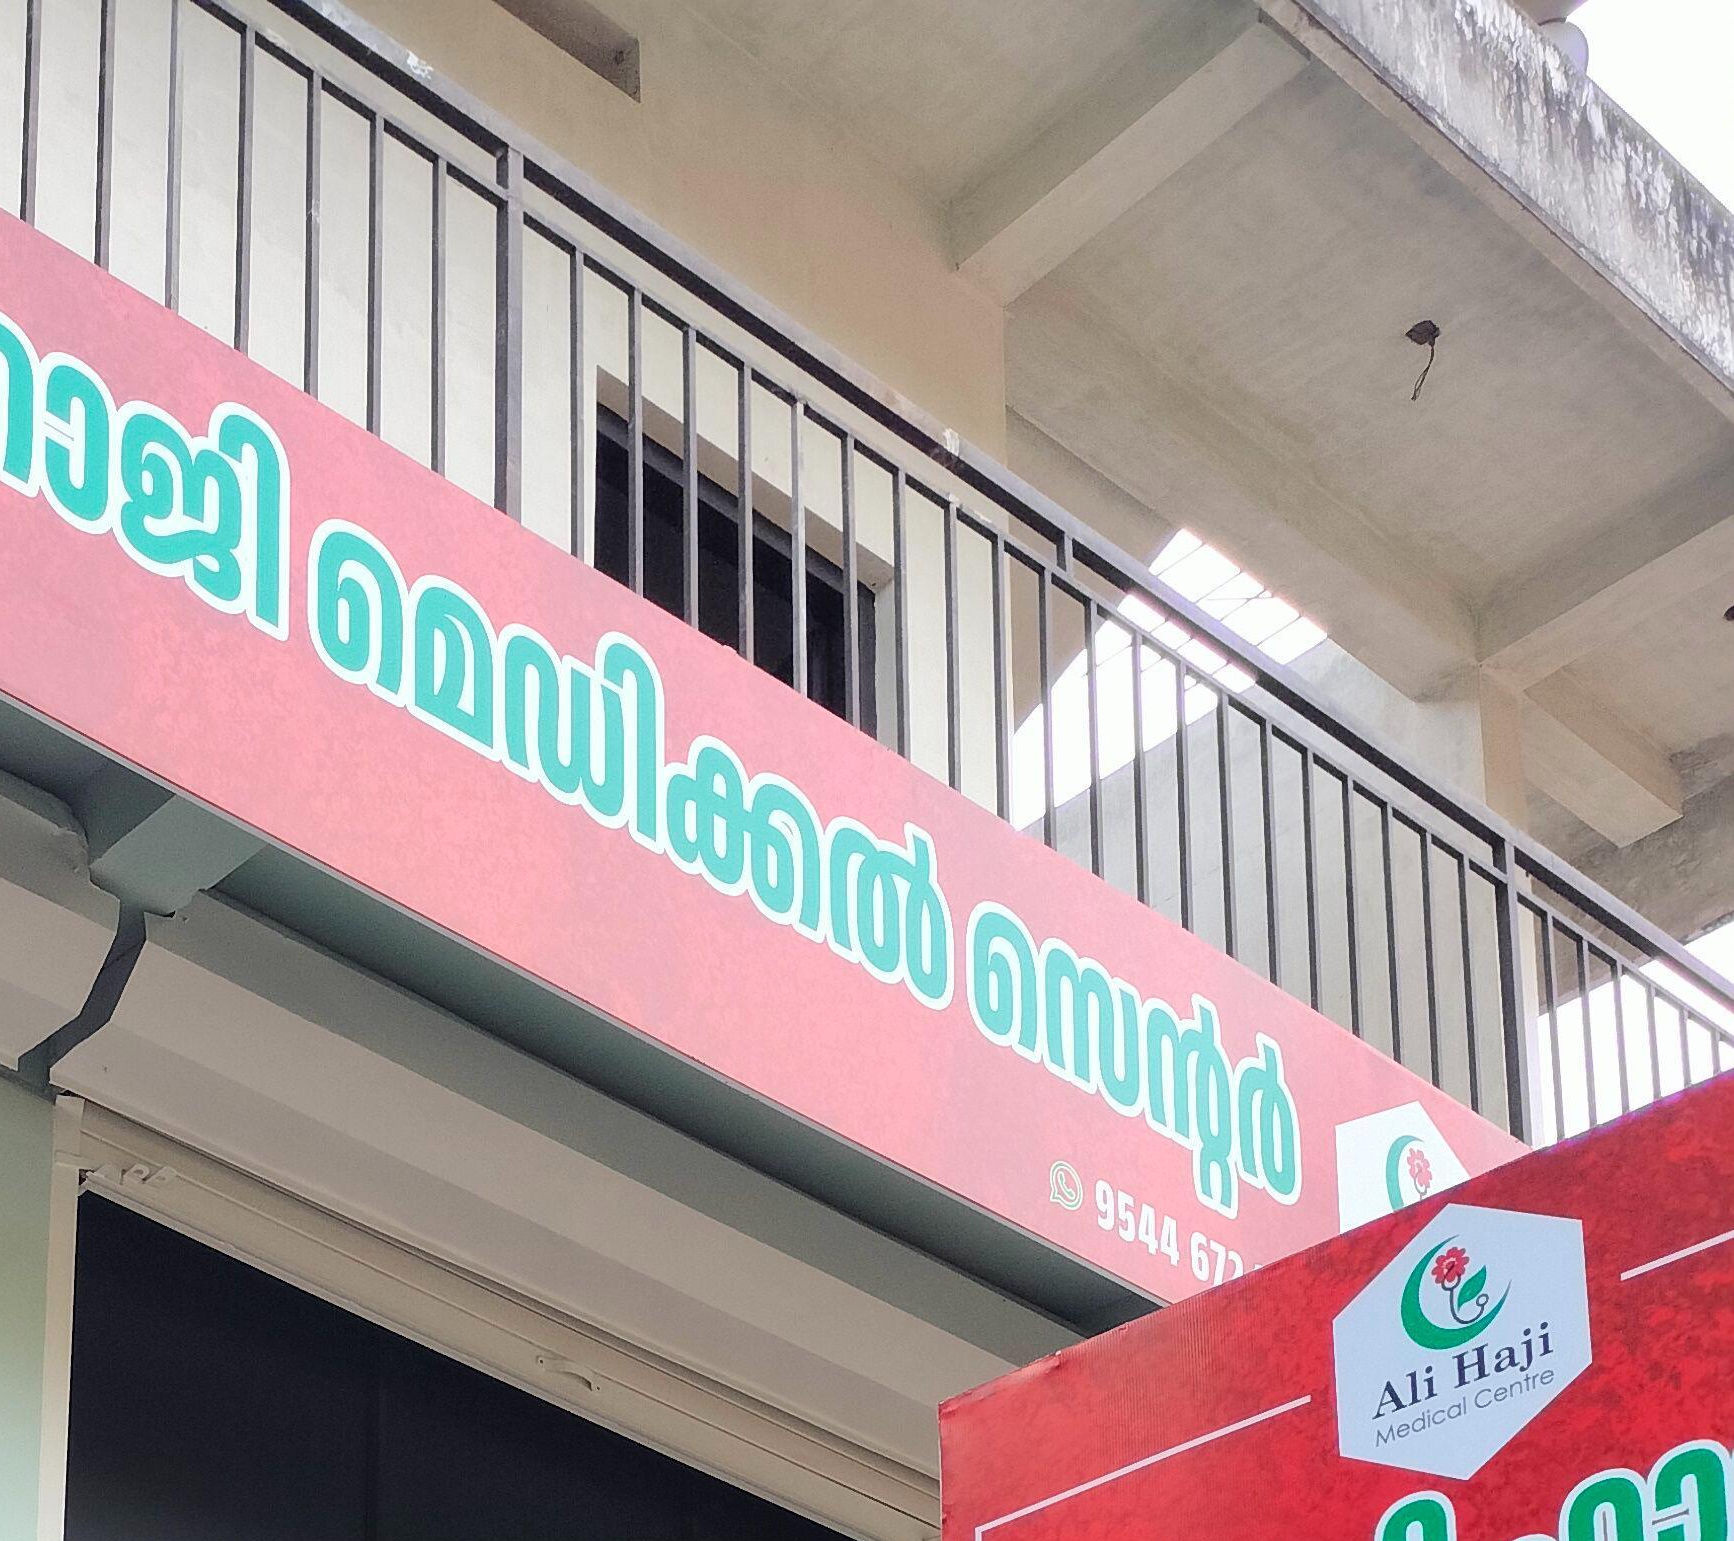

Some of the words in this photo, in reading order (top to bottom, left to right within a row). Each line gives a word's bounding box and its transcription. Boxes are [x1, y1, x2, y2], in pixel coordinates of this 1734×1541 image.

[307, 518, 954, 1010] മെഡിക്കൽ
[1095, 1179, 1180, 1267] 9544
[1372, 1365, 1438, 1420] Ali
[1452, 1321, 1554, 1389] Haji
[1375, 1396, 1467, 1447] Medical
[1474, 1369, 1555, 1409] Centre
